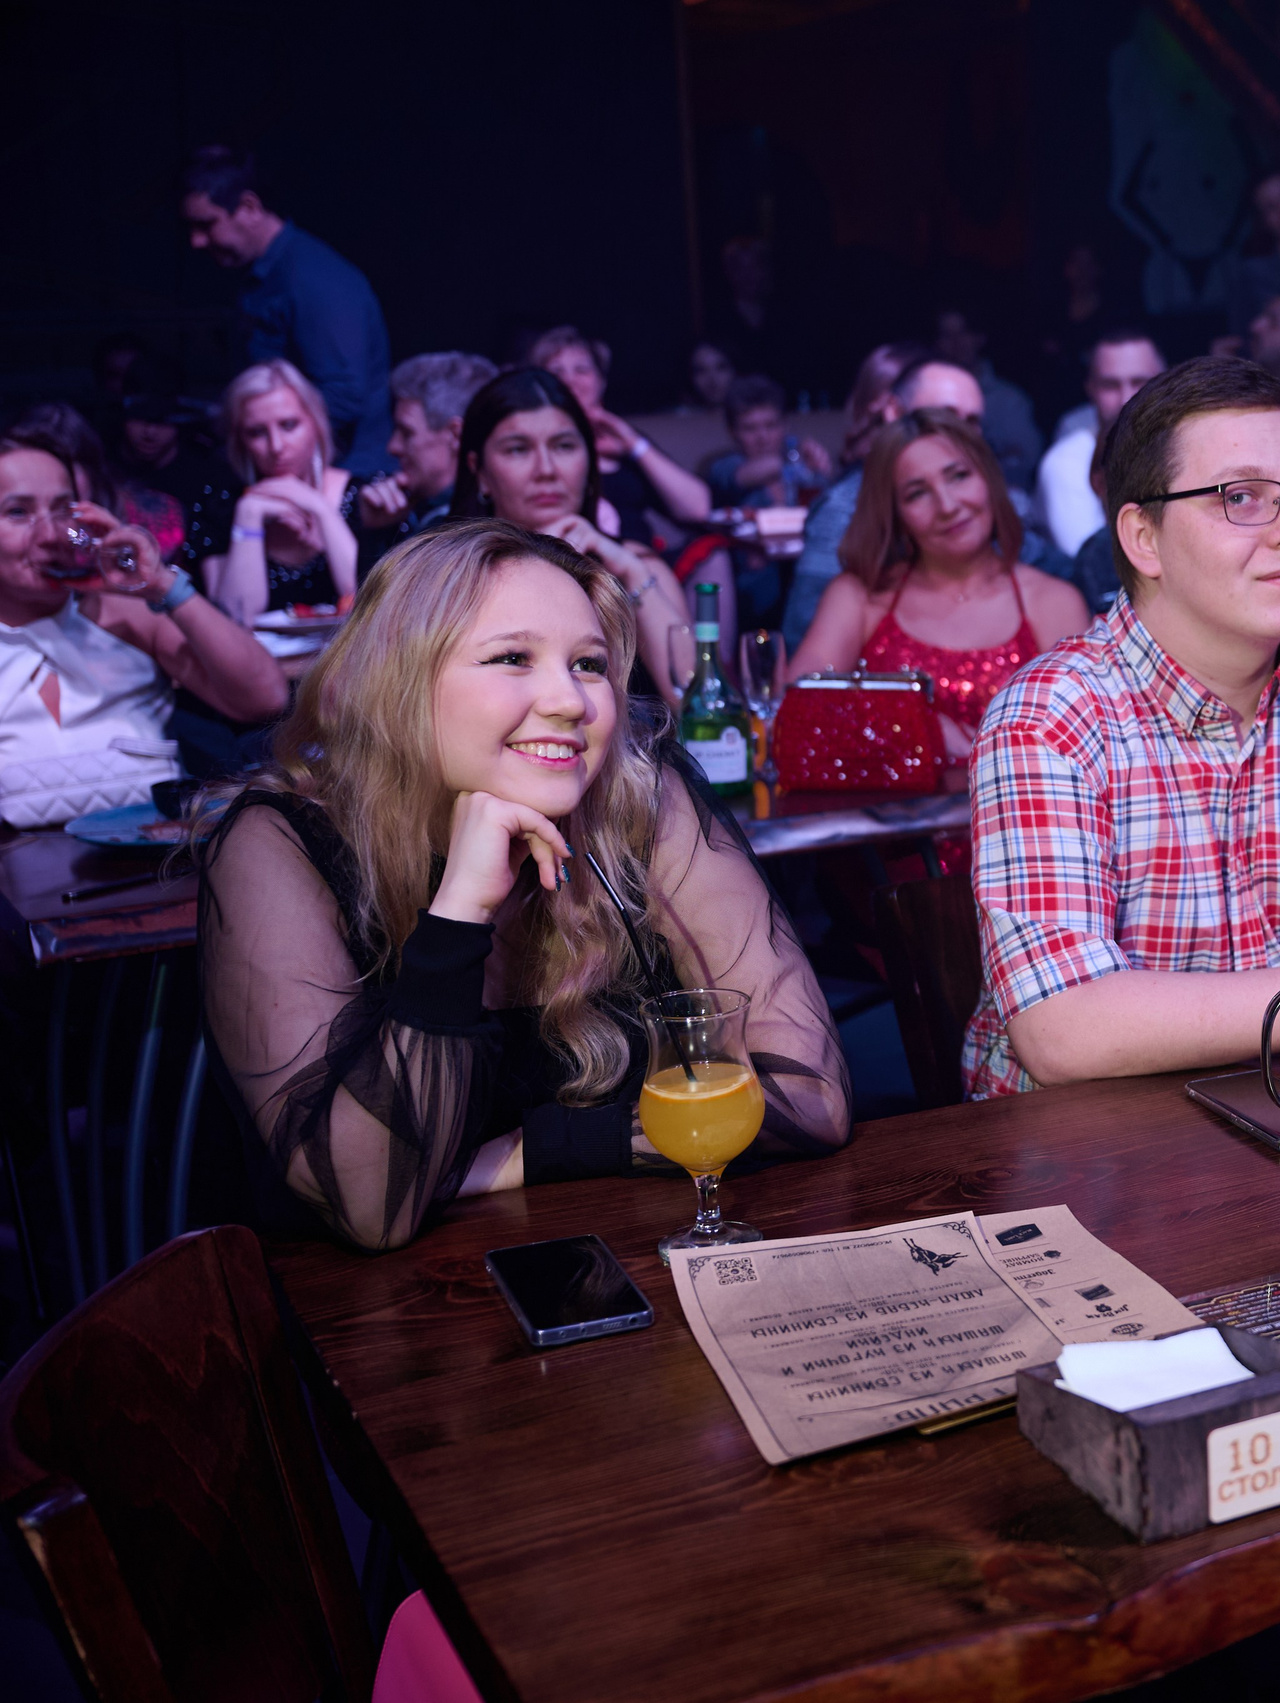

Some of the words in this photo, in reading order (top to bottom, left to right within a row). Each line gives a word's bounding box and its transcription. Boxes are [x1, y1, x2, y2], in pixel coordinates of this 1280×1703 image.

[1004, 1256, 1044, 1268] BOMBAY
[843, 1309, 869, 1322] ИЗ
[921, 1323, 1005, 1348] ШАШЛЫК
[890, 1341, 917, 1354] ИЗ
[800, 1346, 886, 1372] КУРОЧКИ
[939, 1349, 1027, 1375] ШАШЛЫК
[779, 1365, 795, 1377] И
[907, 1368, 935, 1382] ИЗ
[1229, 1432, 1272, 1474] 10
